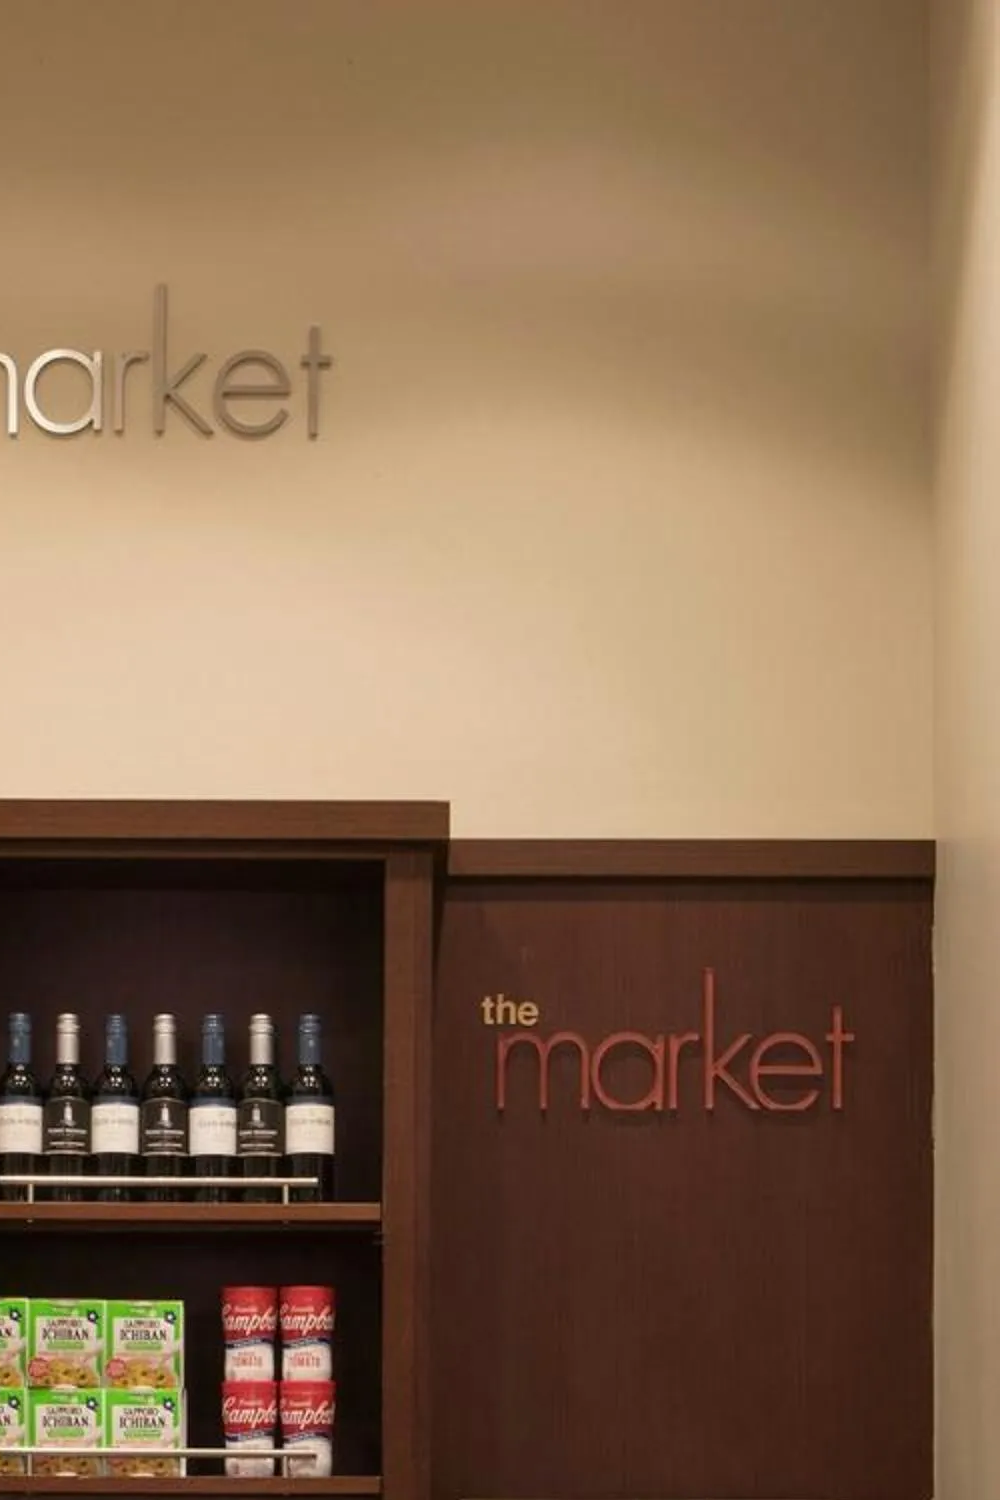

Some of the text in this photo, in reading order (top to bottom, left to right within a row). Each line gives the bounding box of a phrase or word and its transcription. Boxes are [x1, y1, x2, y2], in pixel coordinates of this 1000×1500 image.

[481, 994, 539, 1026] the
[496, 966, 855, 1111] market
[42, 1328, 89, 1340] ICHIBAN
[120, 1329, 167, 1341] ICHIBAN
[42, 1416, 89, 1428] ICHIBAN
[119, 1416, 166, 1428] ICHIBAN
